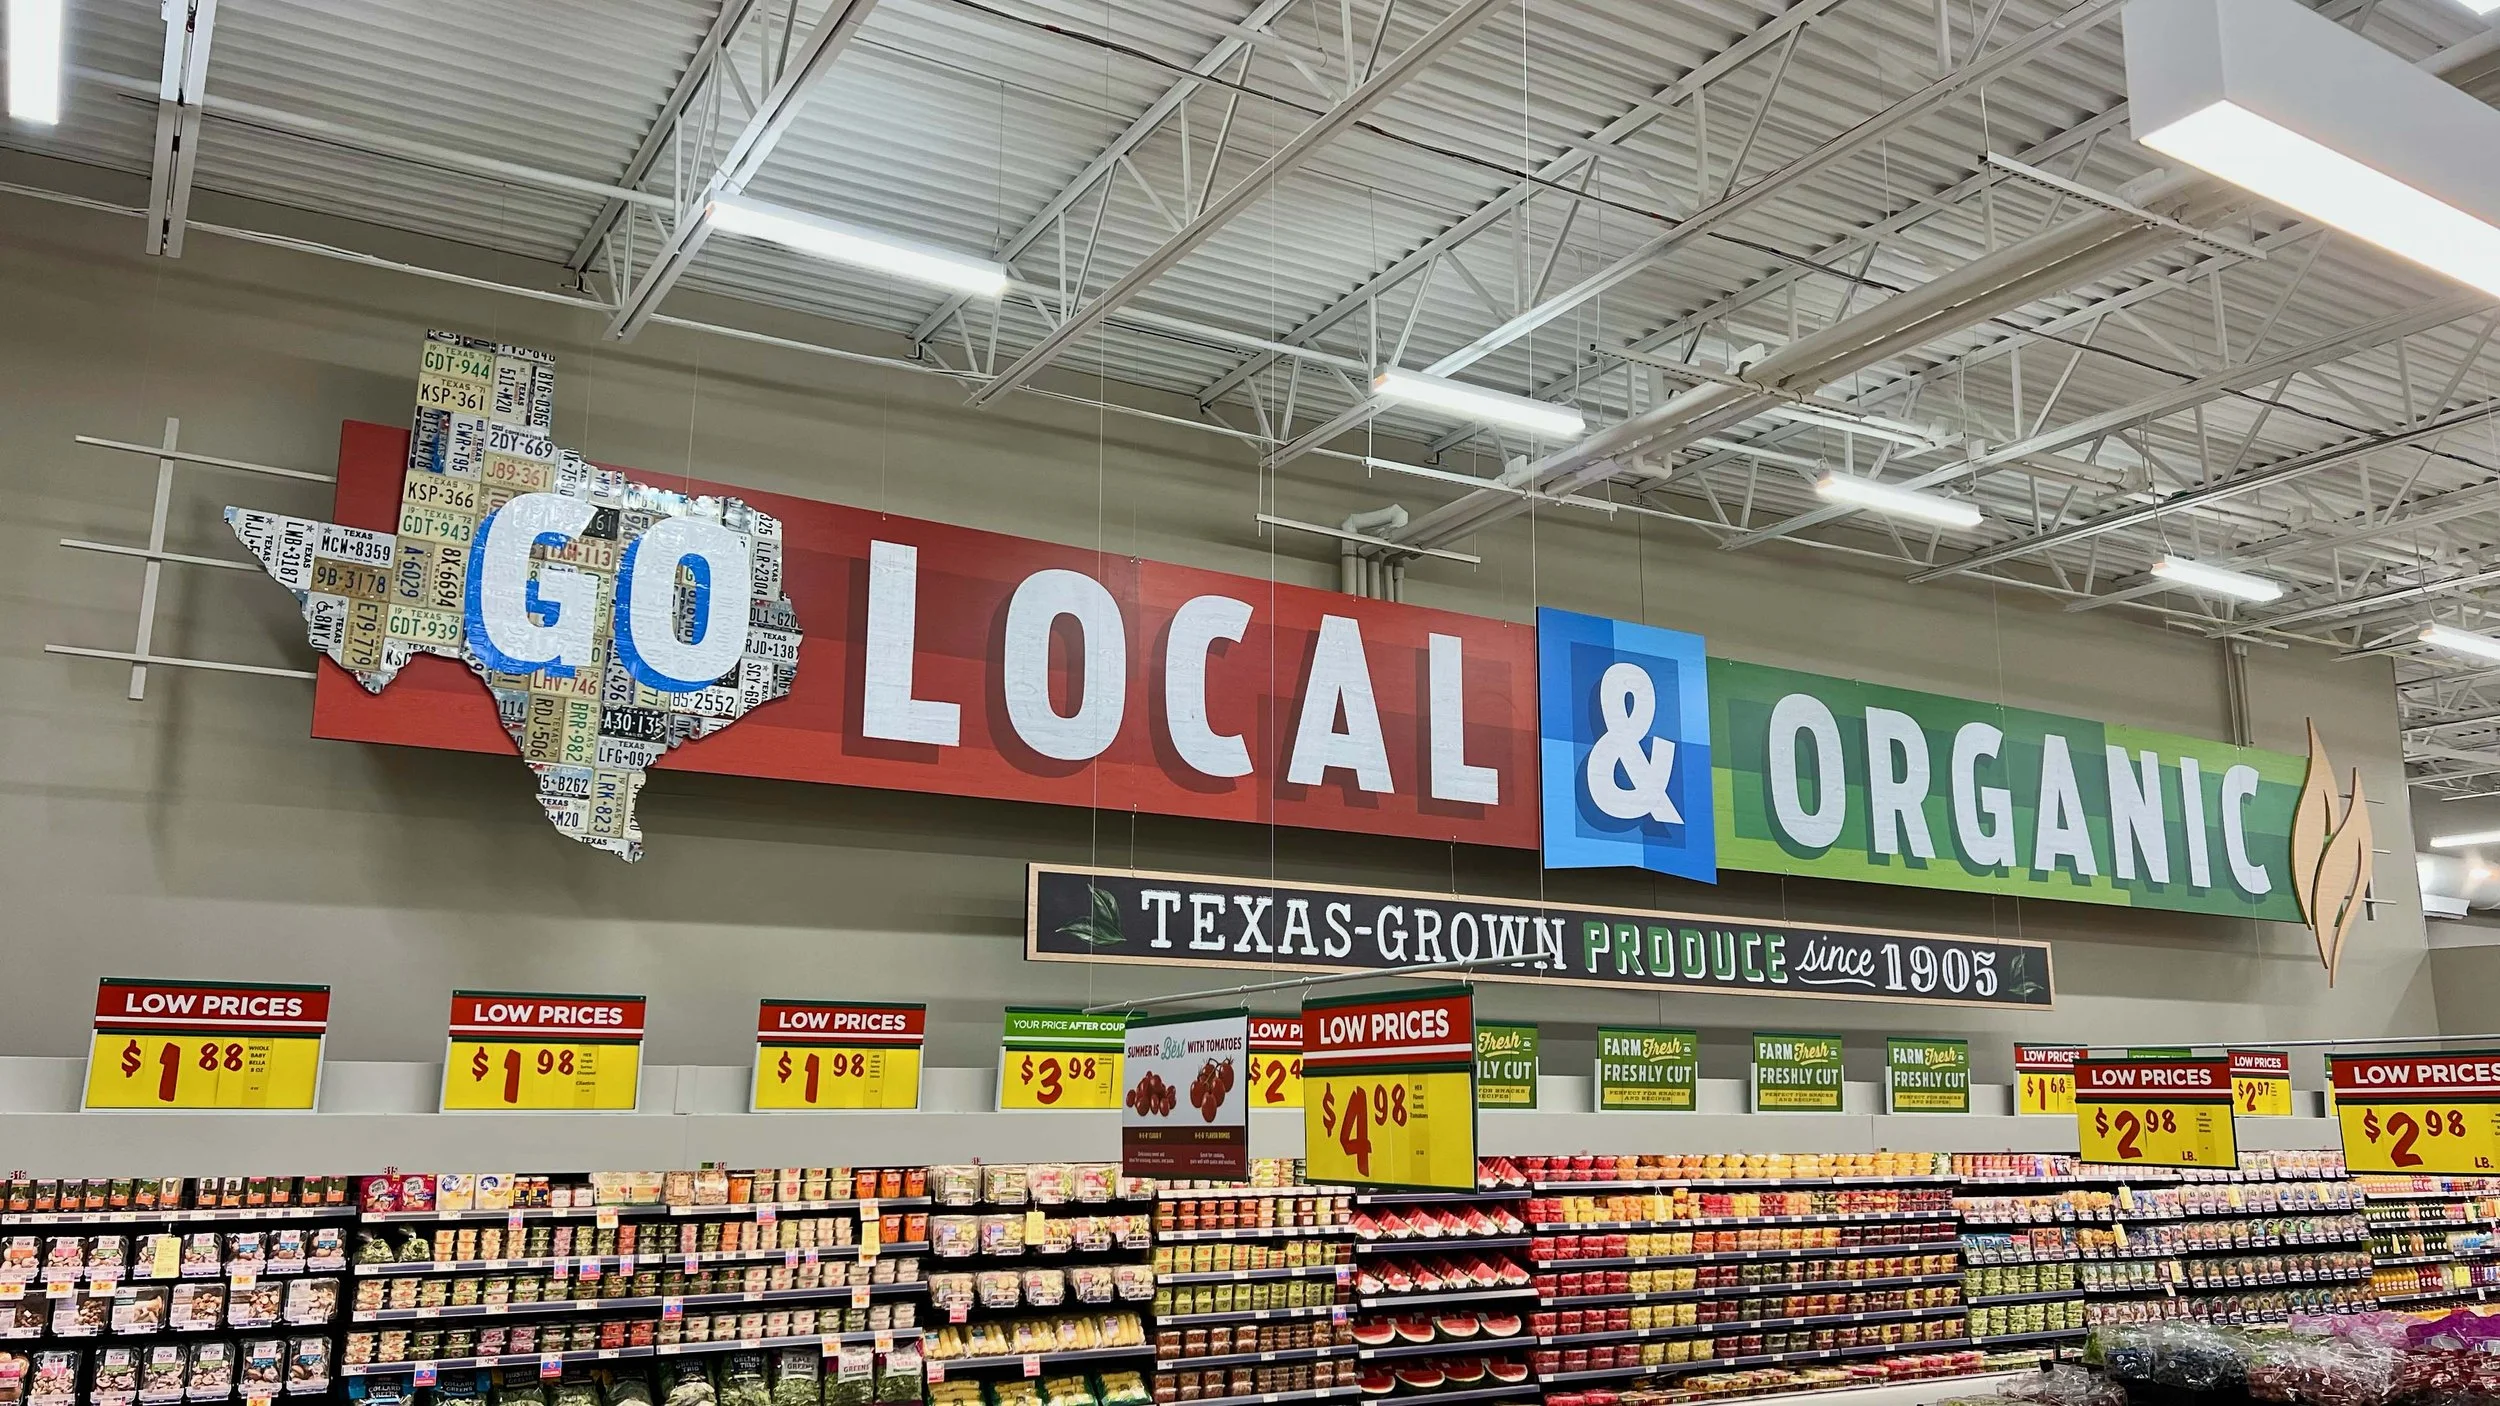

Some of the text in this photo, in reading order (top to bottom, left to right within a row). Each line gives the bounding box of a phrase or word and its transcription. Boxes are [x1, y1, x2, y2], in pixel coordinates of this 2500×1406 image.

[445, 347, 475, 359] TEXAS
[441, 379, 470, 391] TEXAS
[475, 437, 484, 462] TEXAS
[428, 476, 458, 488] TEXAS
[424, 509, 454, 522] TEXAS
[344, 528, 373, 540] TEXAS
[262, 534, 274, 562] TEXAS
[302, 542, 314, 568] TEXAS
[411, 610, 442, 620] TEXAS
[334, 617, 344, 644] TEXAS
[764, 632, 786, 641] TEXAS
[482, 492, 2272, 895] GO LOCAL & ORGANIC
[550, 716, 560, 744] TEXAS
[586, 722, 596, 748] TEXAS
[618, 740, 645, 750] TEXAS
[542, 798, 568, 806] TEXAS
[614, 792, 624, 818] TEXAS
[581, 836, 608, 846] TEXAS
[1141, 889, 1998, 997] TEXAS-GROWN PRODUCE since 1905
[126, 993, 302, 1017] LOW PRICES
[474, 1004, 623, 1025] LOW PRICES
[779, 1012, 906, 1030] LOW PRICES
[1014, 1020, 1040, 1029] YOUR
[1042, 1020, 1068, 1030] PRICE
[1069, 1022, 1098, 1030] AFTER
[1250, 1023, 1287, 1038] LOW
[1320, 1014, 1366, 1044] LOW
[1372, 1008, 1450, 1041] PRICES
[1128, 1036, 1242, 1060] SUMMER IS Best WITH TOMATOES
[1478, 1031, 1521, 1053] Fresh
[1604, 1038, 1641, 1056] FARM
[1642, 1037, 1682, 1058] Fresh
[1760, 1042, 1792, 1060] FARM
[1794, 1042, 1829, 1062] Fresh
[1894, 1048, 1924, 1064] FARM
[1925, 1047, 1957, 1066] Fresh
[2024, 1050, 2046, 1062] LOW
[1504, 1062, 1532, 1080] CUT
[2234, 1056, 2281, 1068] LOW PRICES
[1604, 1064, 1692, 1083] FRESHLY CUT
[1760, 1067, 1838, 1085] FRESHLY CUT
[1894, 1071, 1966, 1088] FRESHLY CUT
[2092, 1069, 2212, 1086] LOW PRICES
[2353, 1065, 2410, 1084] LOW
[2474, 1156, 2494, 1168] LB.
